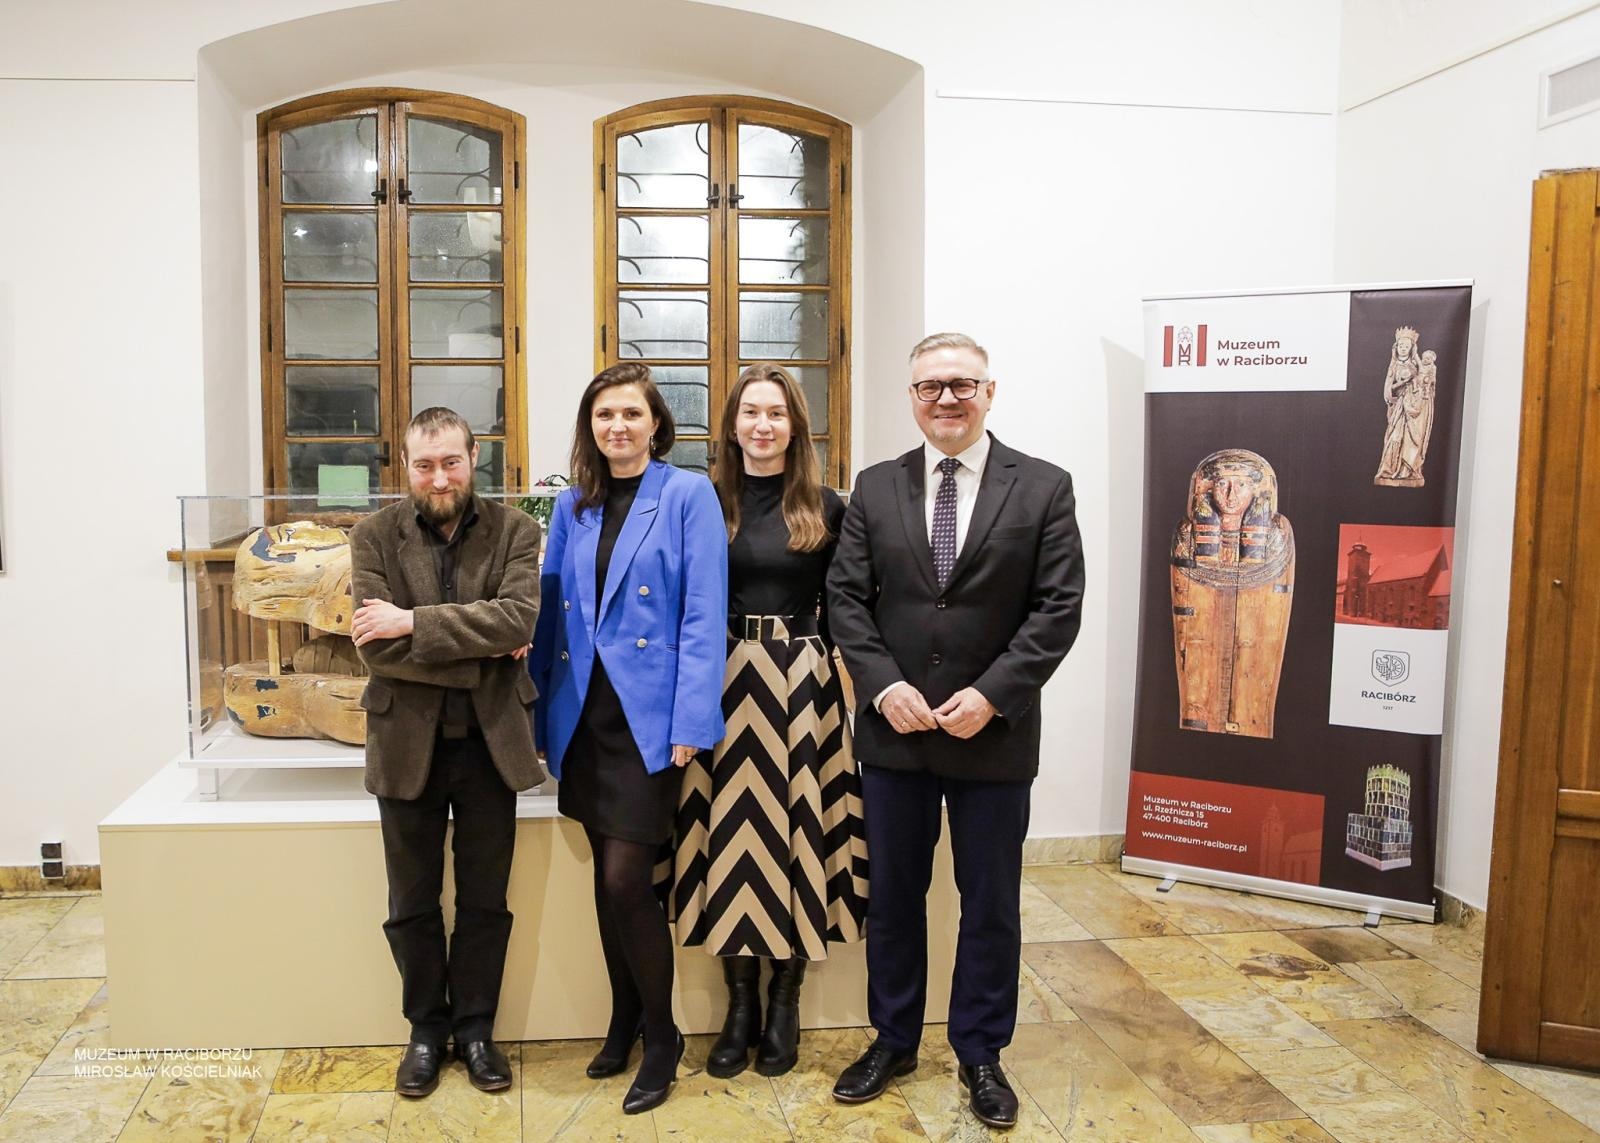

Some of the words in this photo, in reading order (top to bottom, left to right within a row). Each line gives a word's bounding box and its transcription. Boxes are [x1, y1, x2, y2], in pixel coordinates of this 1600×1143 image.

[1217, 339, 1280, 351] Muzeum
[1217, 357, 1229, 367] w
[1234, 354, 1308, 367] Raciborzu
[1361, 690, 1416, 703] RACIBÓRZ
[1143, 794, 1179, 806] Muzeum
[1190, 801, 1232, 813] Raciborzu
[1154, 805, 1195, 817] Rzeźnicza
[1195, 810, 1205, 819] 15
[1142, 813, 1171, 823] 47-400
[1172, 816, 1209, 829] Racibórz
[1141, 830, 1248, 853] www.muzeum-raciborz.pl
